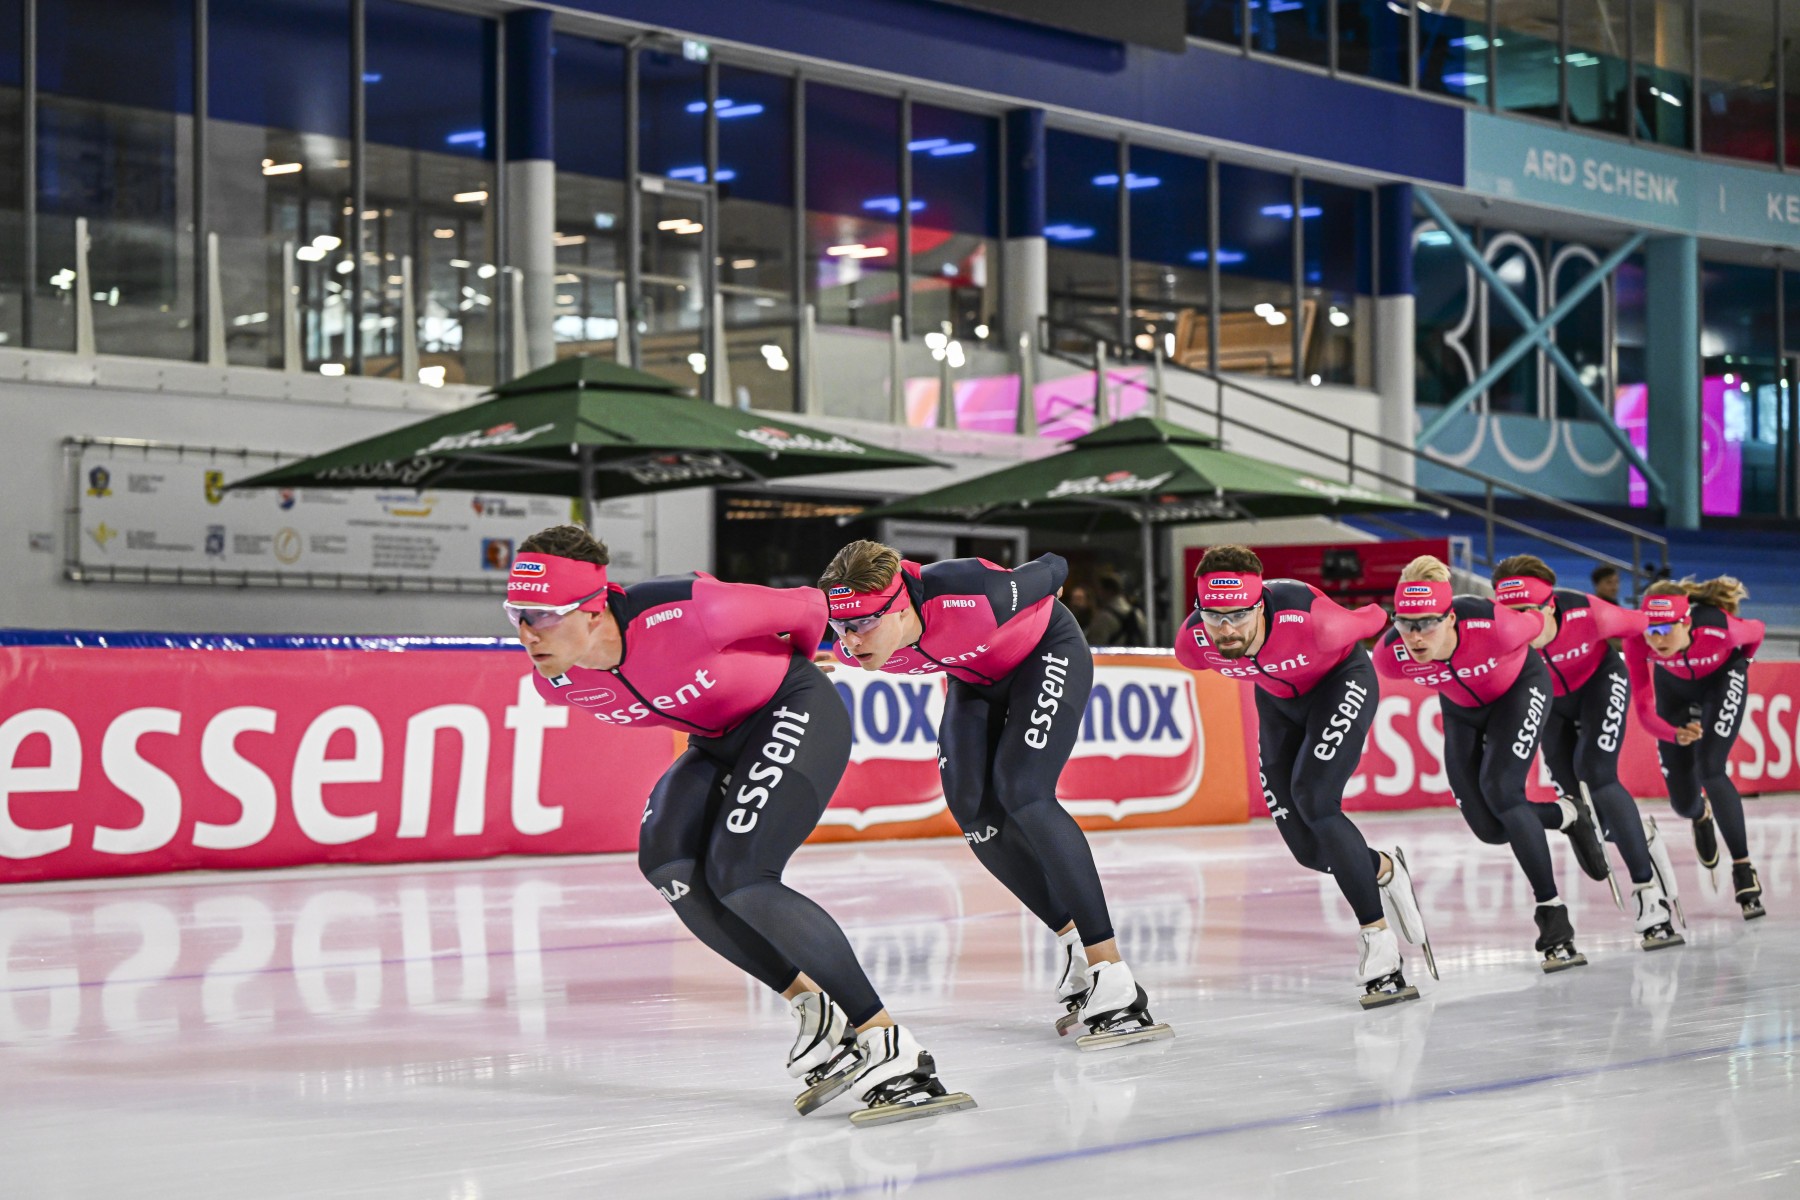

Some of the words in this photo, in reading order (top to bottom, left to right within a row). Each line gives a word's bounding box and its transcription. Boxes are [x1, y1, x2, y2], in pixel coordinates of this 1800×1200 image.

[1523, 149, 1577, 186] ARD
[1583, 159, 1680, 206] SCHENK
[830, 600, 862, 610] ssent
[943, 600, 976, 609] JUMBO
[1204, 592, 1248, 600] essent
[1399, 599, 1437, 607] essent
[645, 607, 683, 629] JUMBO
[1279, 614, 1304, 624] JUMBO
[908, 643, 991, 675] ssent
[1220, 653, 1310, 677] essent
[1414, 657, 1498, 686] essent
[594, 668, 717, 725] essent
[1024, 652, 1069, 750] essent
[1076, 683, 1183, 741] nox
[1597, 672, 1628, 752] essent
[1714, 669, 1745, 738] essent
[1314, 680, 1367, 761] essent
[1512, 686, 1547, 760] essent
[0, 673, 568, 859] essent
[726, 706, 810, 834] essent
[965, 825, 999, 844] FILA
[659, 879, 690, 902] ILA
